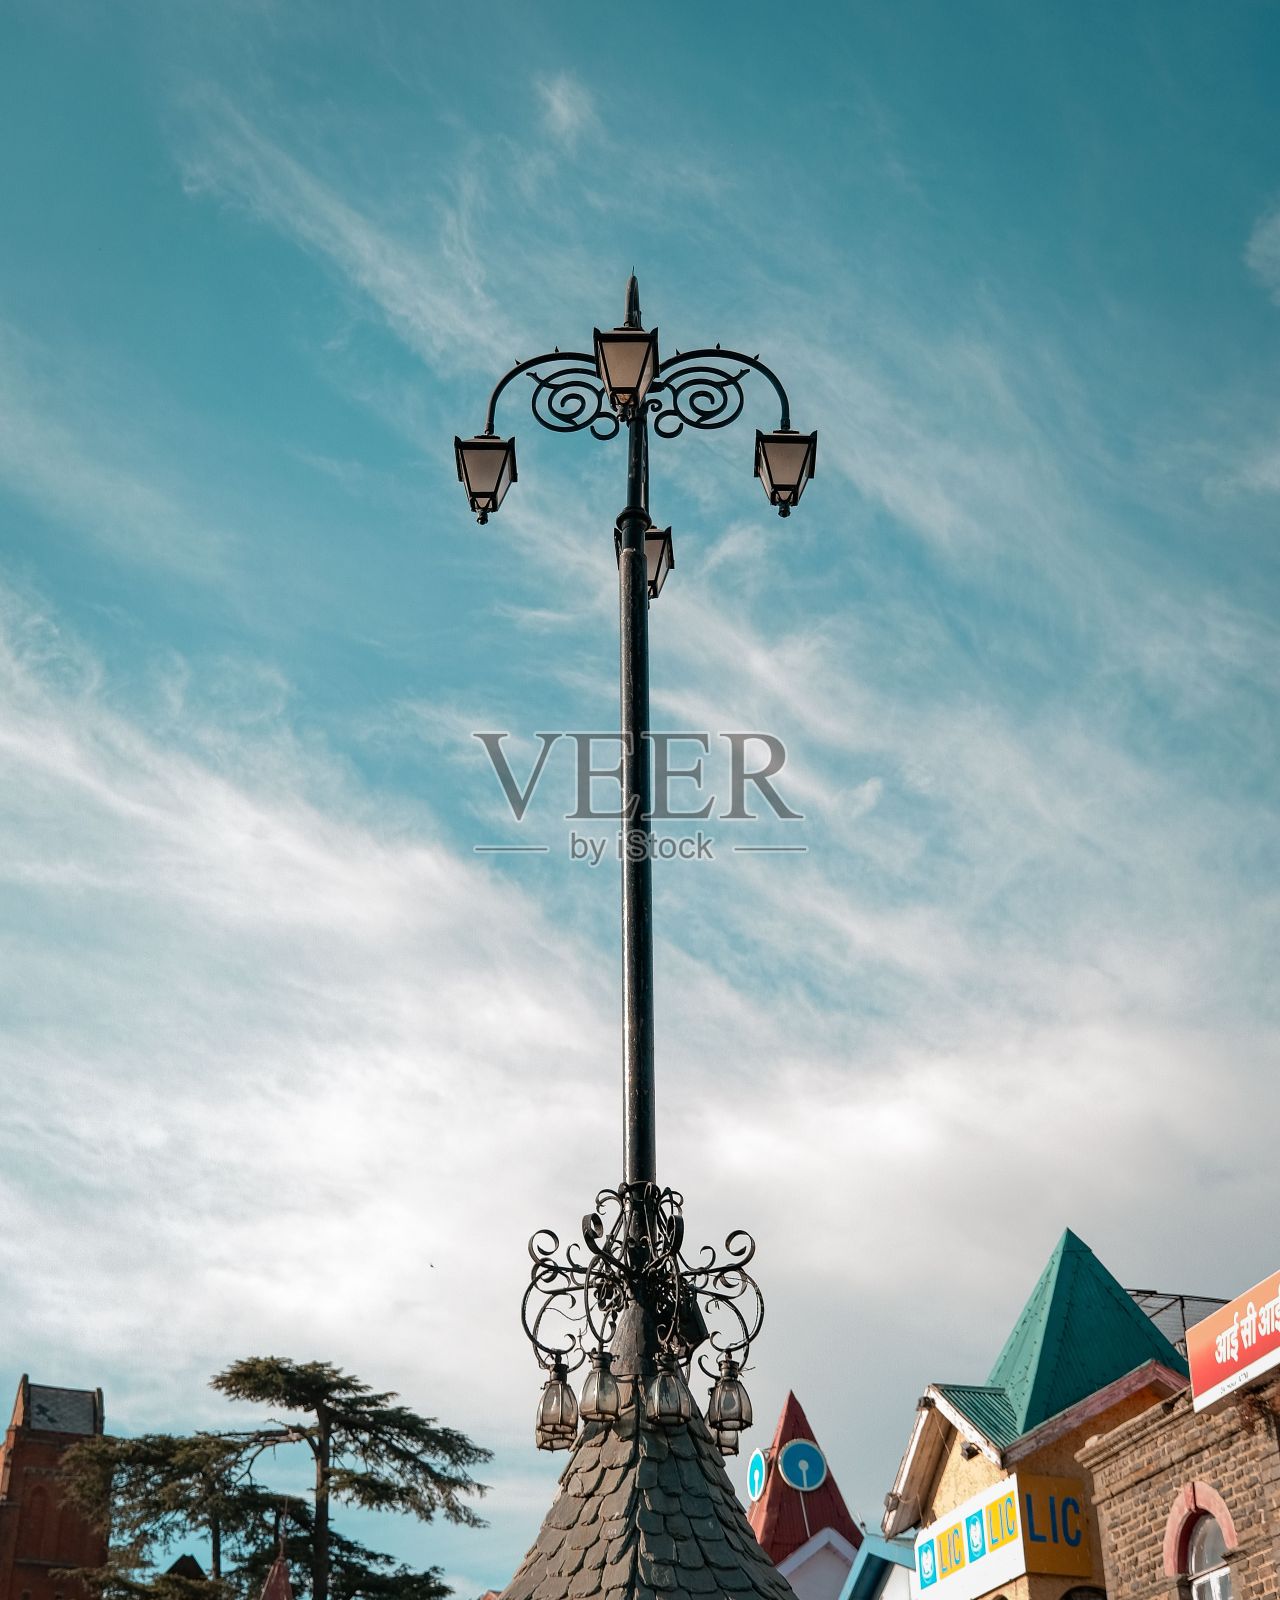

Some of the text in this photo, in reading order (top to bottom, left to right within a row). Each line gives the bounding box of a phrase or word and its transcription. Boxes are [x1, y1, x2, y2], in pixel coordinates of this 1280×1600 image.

[1215, 1311, 1239, 1364] आई
[1240, 1301, 1257, 1350] सी
[938, 1497, 1015, 1573] LIC LIC
[1025, 1493, 1082, 1547] LIC
